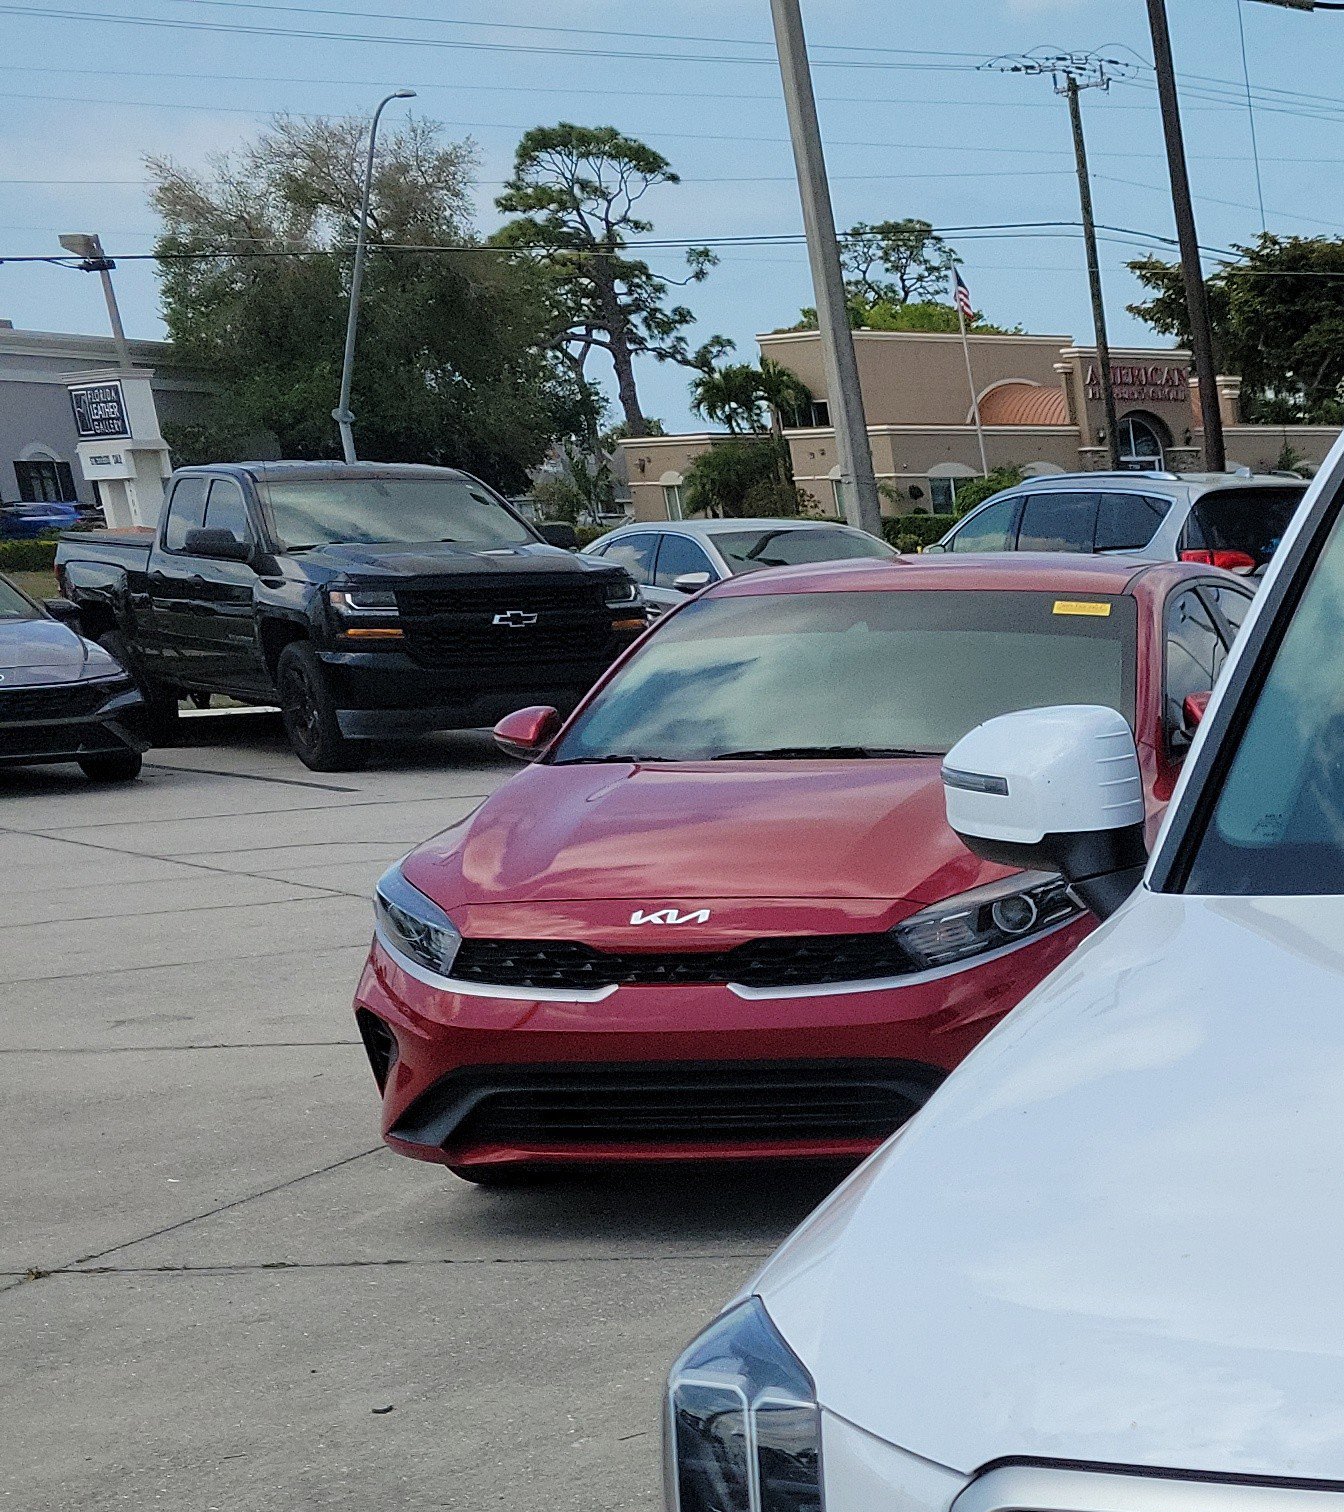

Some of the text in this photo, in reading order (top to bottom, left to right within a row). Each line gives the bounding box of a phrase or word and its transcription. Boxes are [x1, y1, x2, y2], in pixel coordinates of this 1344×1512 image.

[90, 402, 120, 419] LEATHER
[93, 419, 123, 434] GALLERY
[629, 909, 711, 925] KIA
